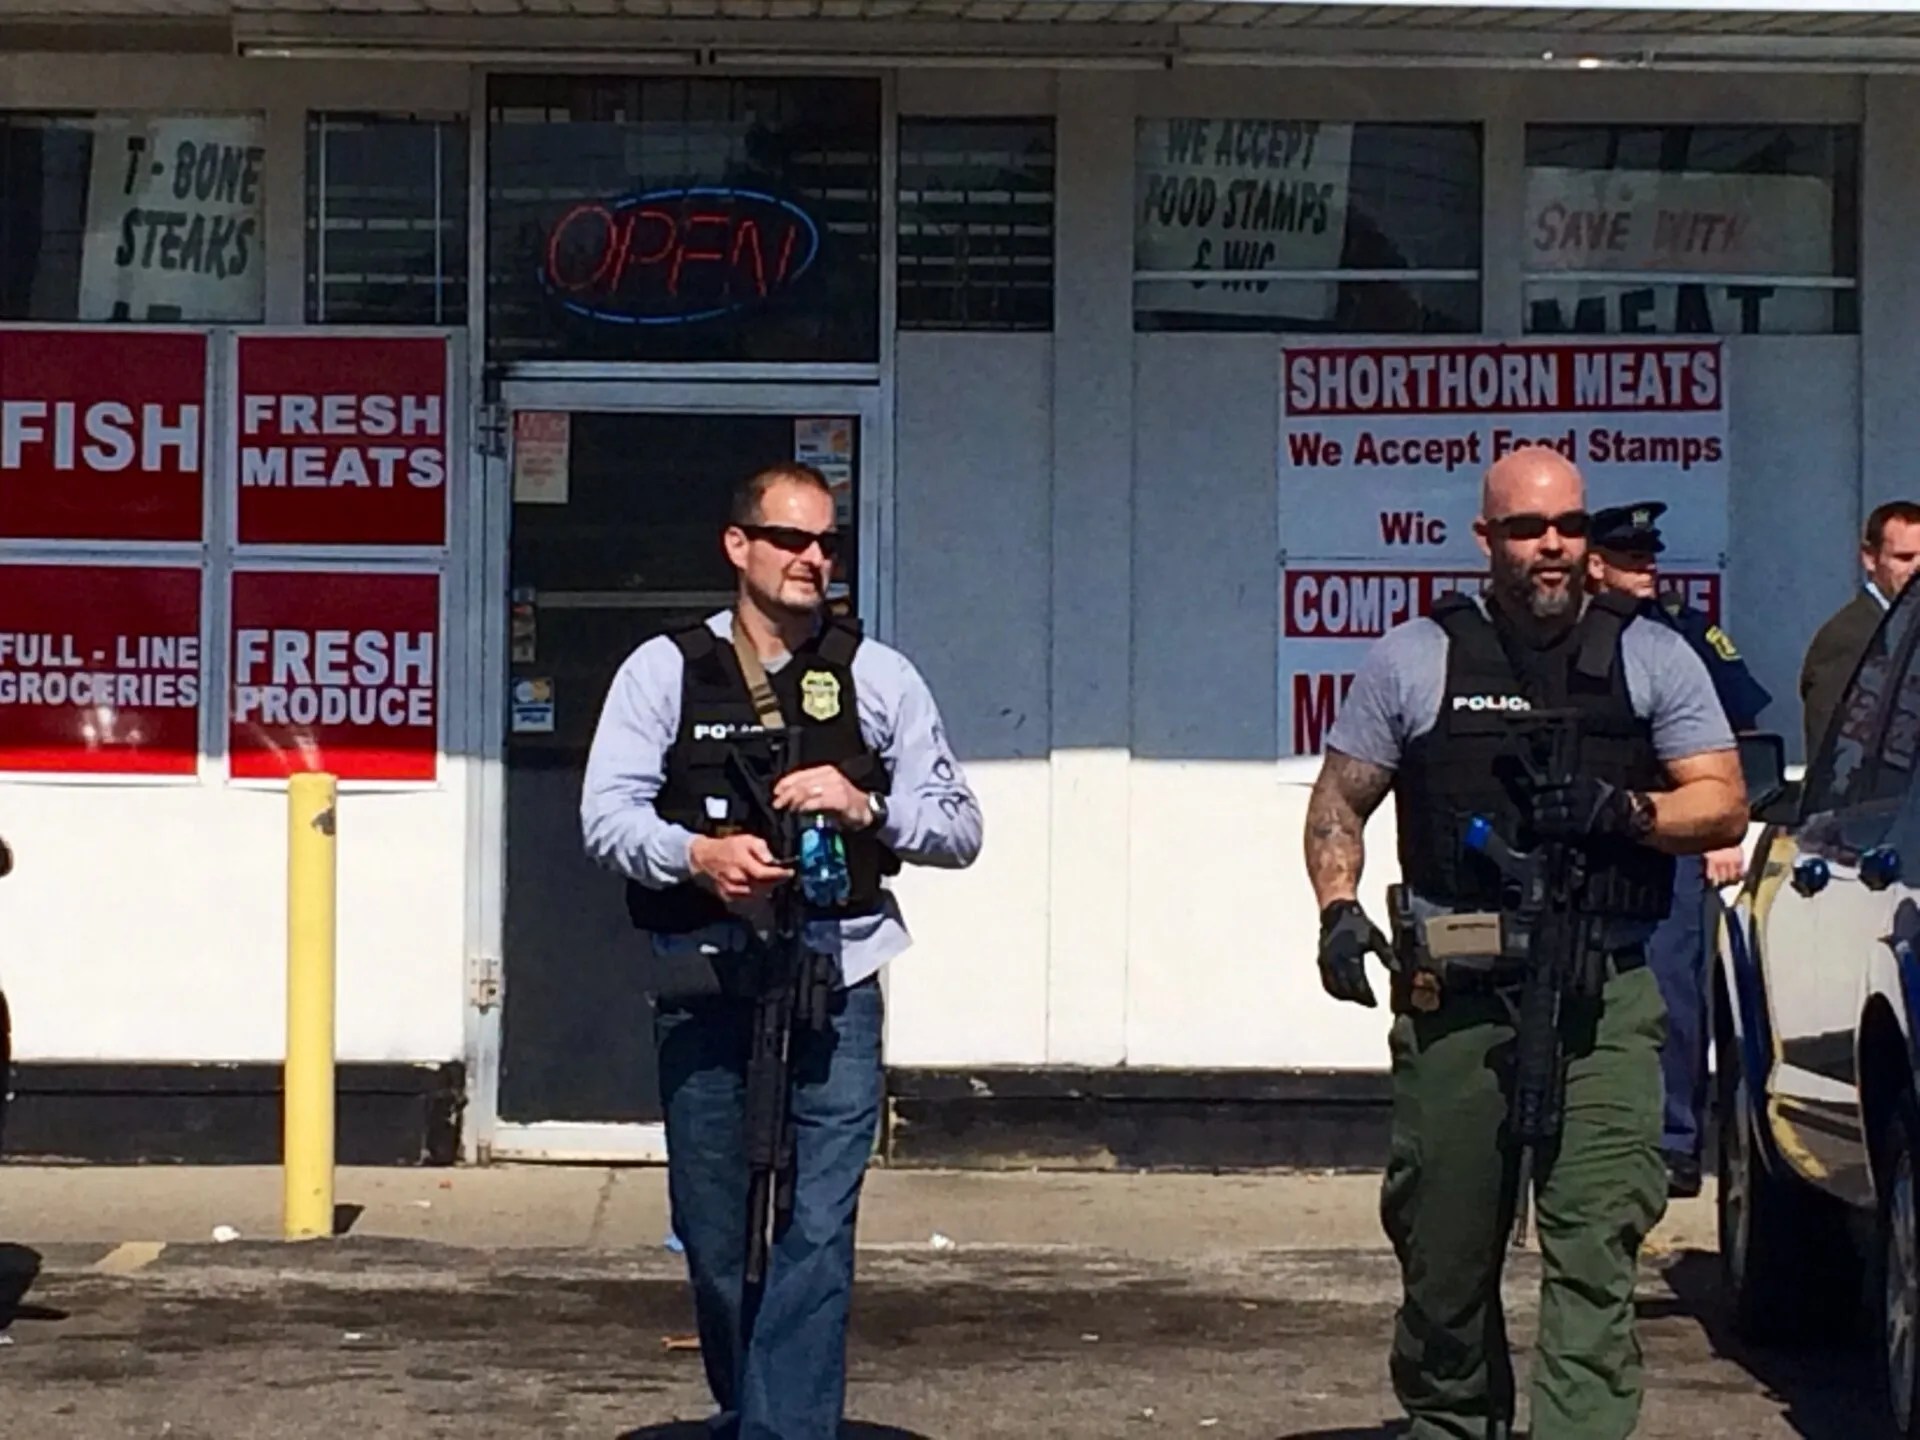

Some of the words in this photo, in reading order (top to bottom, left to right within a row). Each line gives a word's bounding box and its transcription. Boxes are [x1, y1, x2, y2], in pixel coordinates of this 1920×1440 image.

[1144, 174, 1216, 227] FOOD
[1223, 179, 1333, 234] STAMPS
[115, 208, 255, 280] STEAKS
[548, 203, 798, 297] OPEN
[1291, 352, 1558, 410] SHORTHORN
[1574, 350, 1718, 407] MEATS
[0, 402, 199, 472] FISH
[243, 394, 441, 436] FRESH
[241, 446, 446, 488] MEATS
[1289, 433, 1342, 466] We
[1354, 431, 1481, 472] Accept
[1588, 429, 1723, 470] Stamps
[1380, 511, 1447, 545] Wic
[236, 629, 434, 686] FRESH
[0, 670, 199, 708] GROCERIES
[234, 686, 434, 726] PRODUCE
